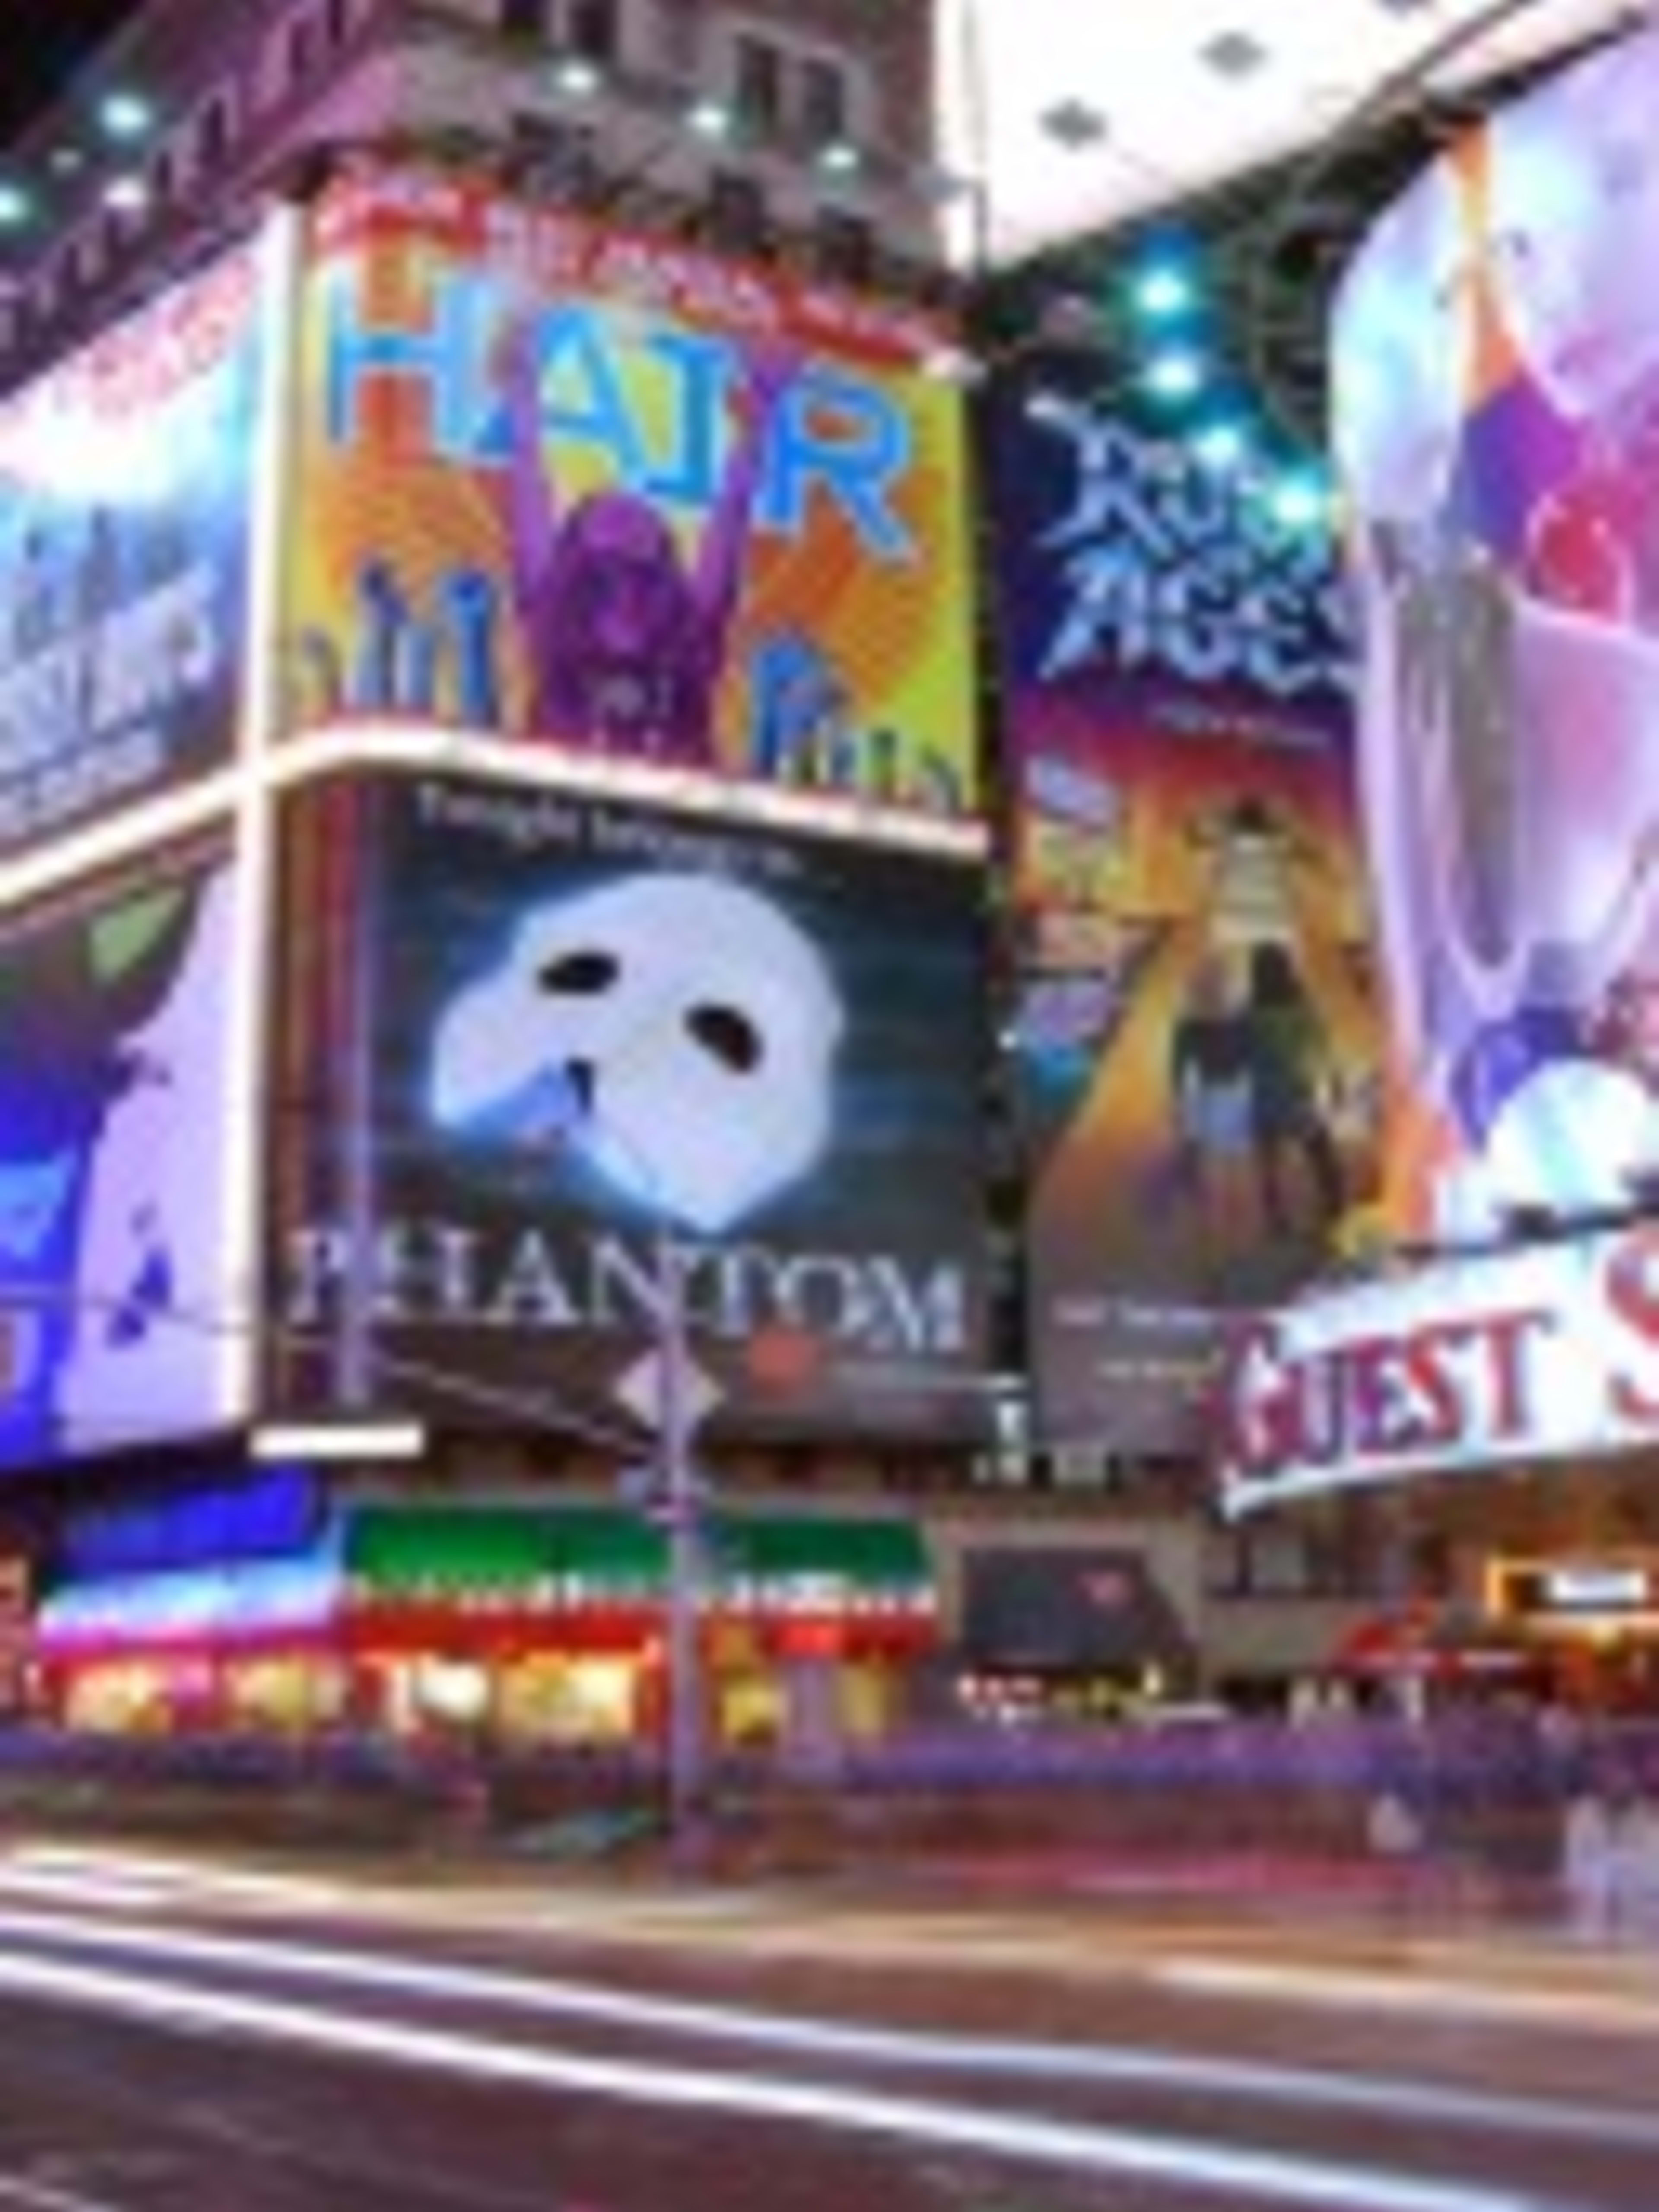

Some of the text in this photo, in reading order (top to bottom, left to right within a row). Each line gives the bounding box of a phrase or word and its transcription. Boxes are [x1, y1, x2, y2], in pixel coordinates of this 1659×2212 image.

[325, 268, 918, 566] HAIR
[287, 1220, 966, 1354] PHANTOM
[1210, 1307, 1557, 1482] GUEST
